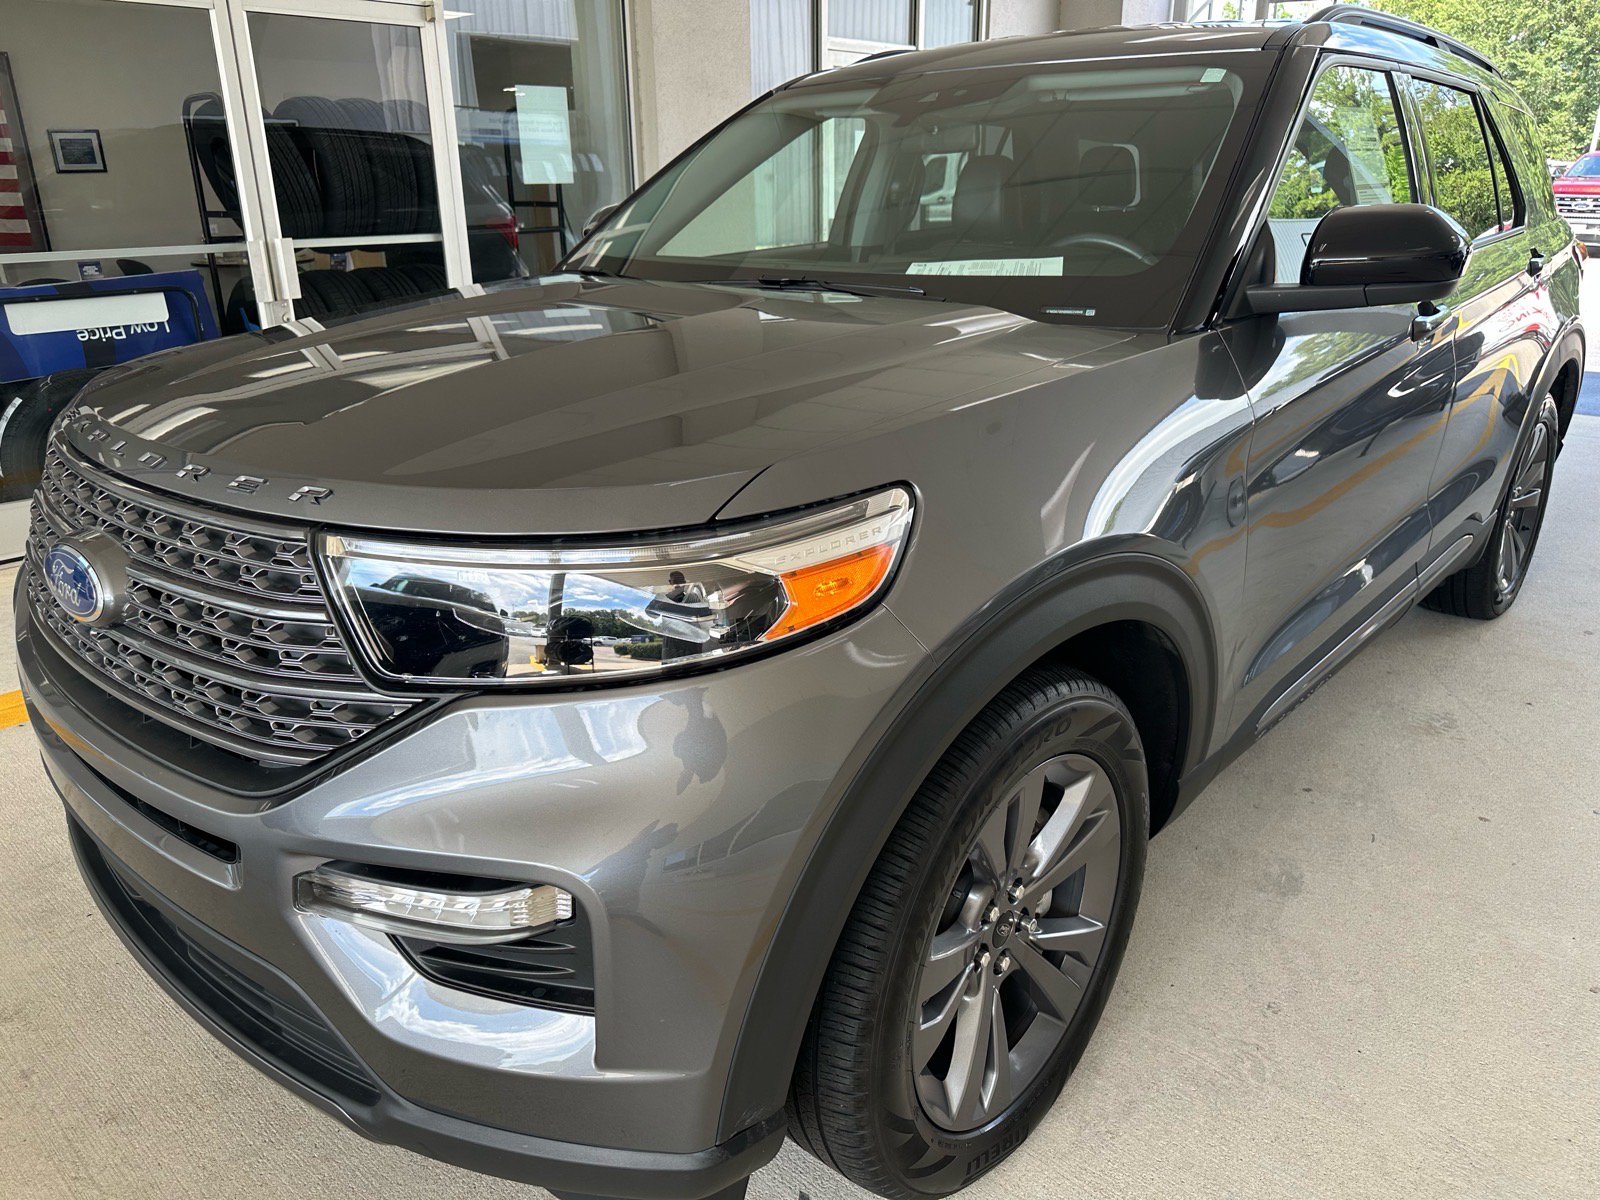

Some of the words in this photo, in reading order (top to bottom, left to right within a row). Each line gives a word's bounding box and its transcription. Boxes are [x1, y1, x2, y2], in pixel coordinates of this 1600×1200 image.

[77, 325, 127, 342] Price
[774, 526, 883, 565] EXPLORER
[52, 559, 80, 606] Ford
